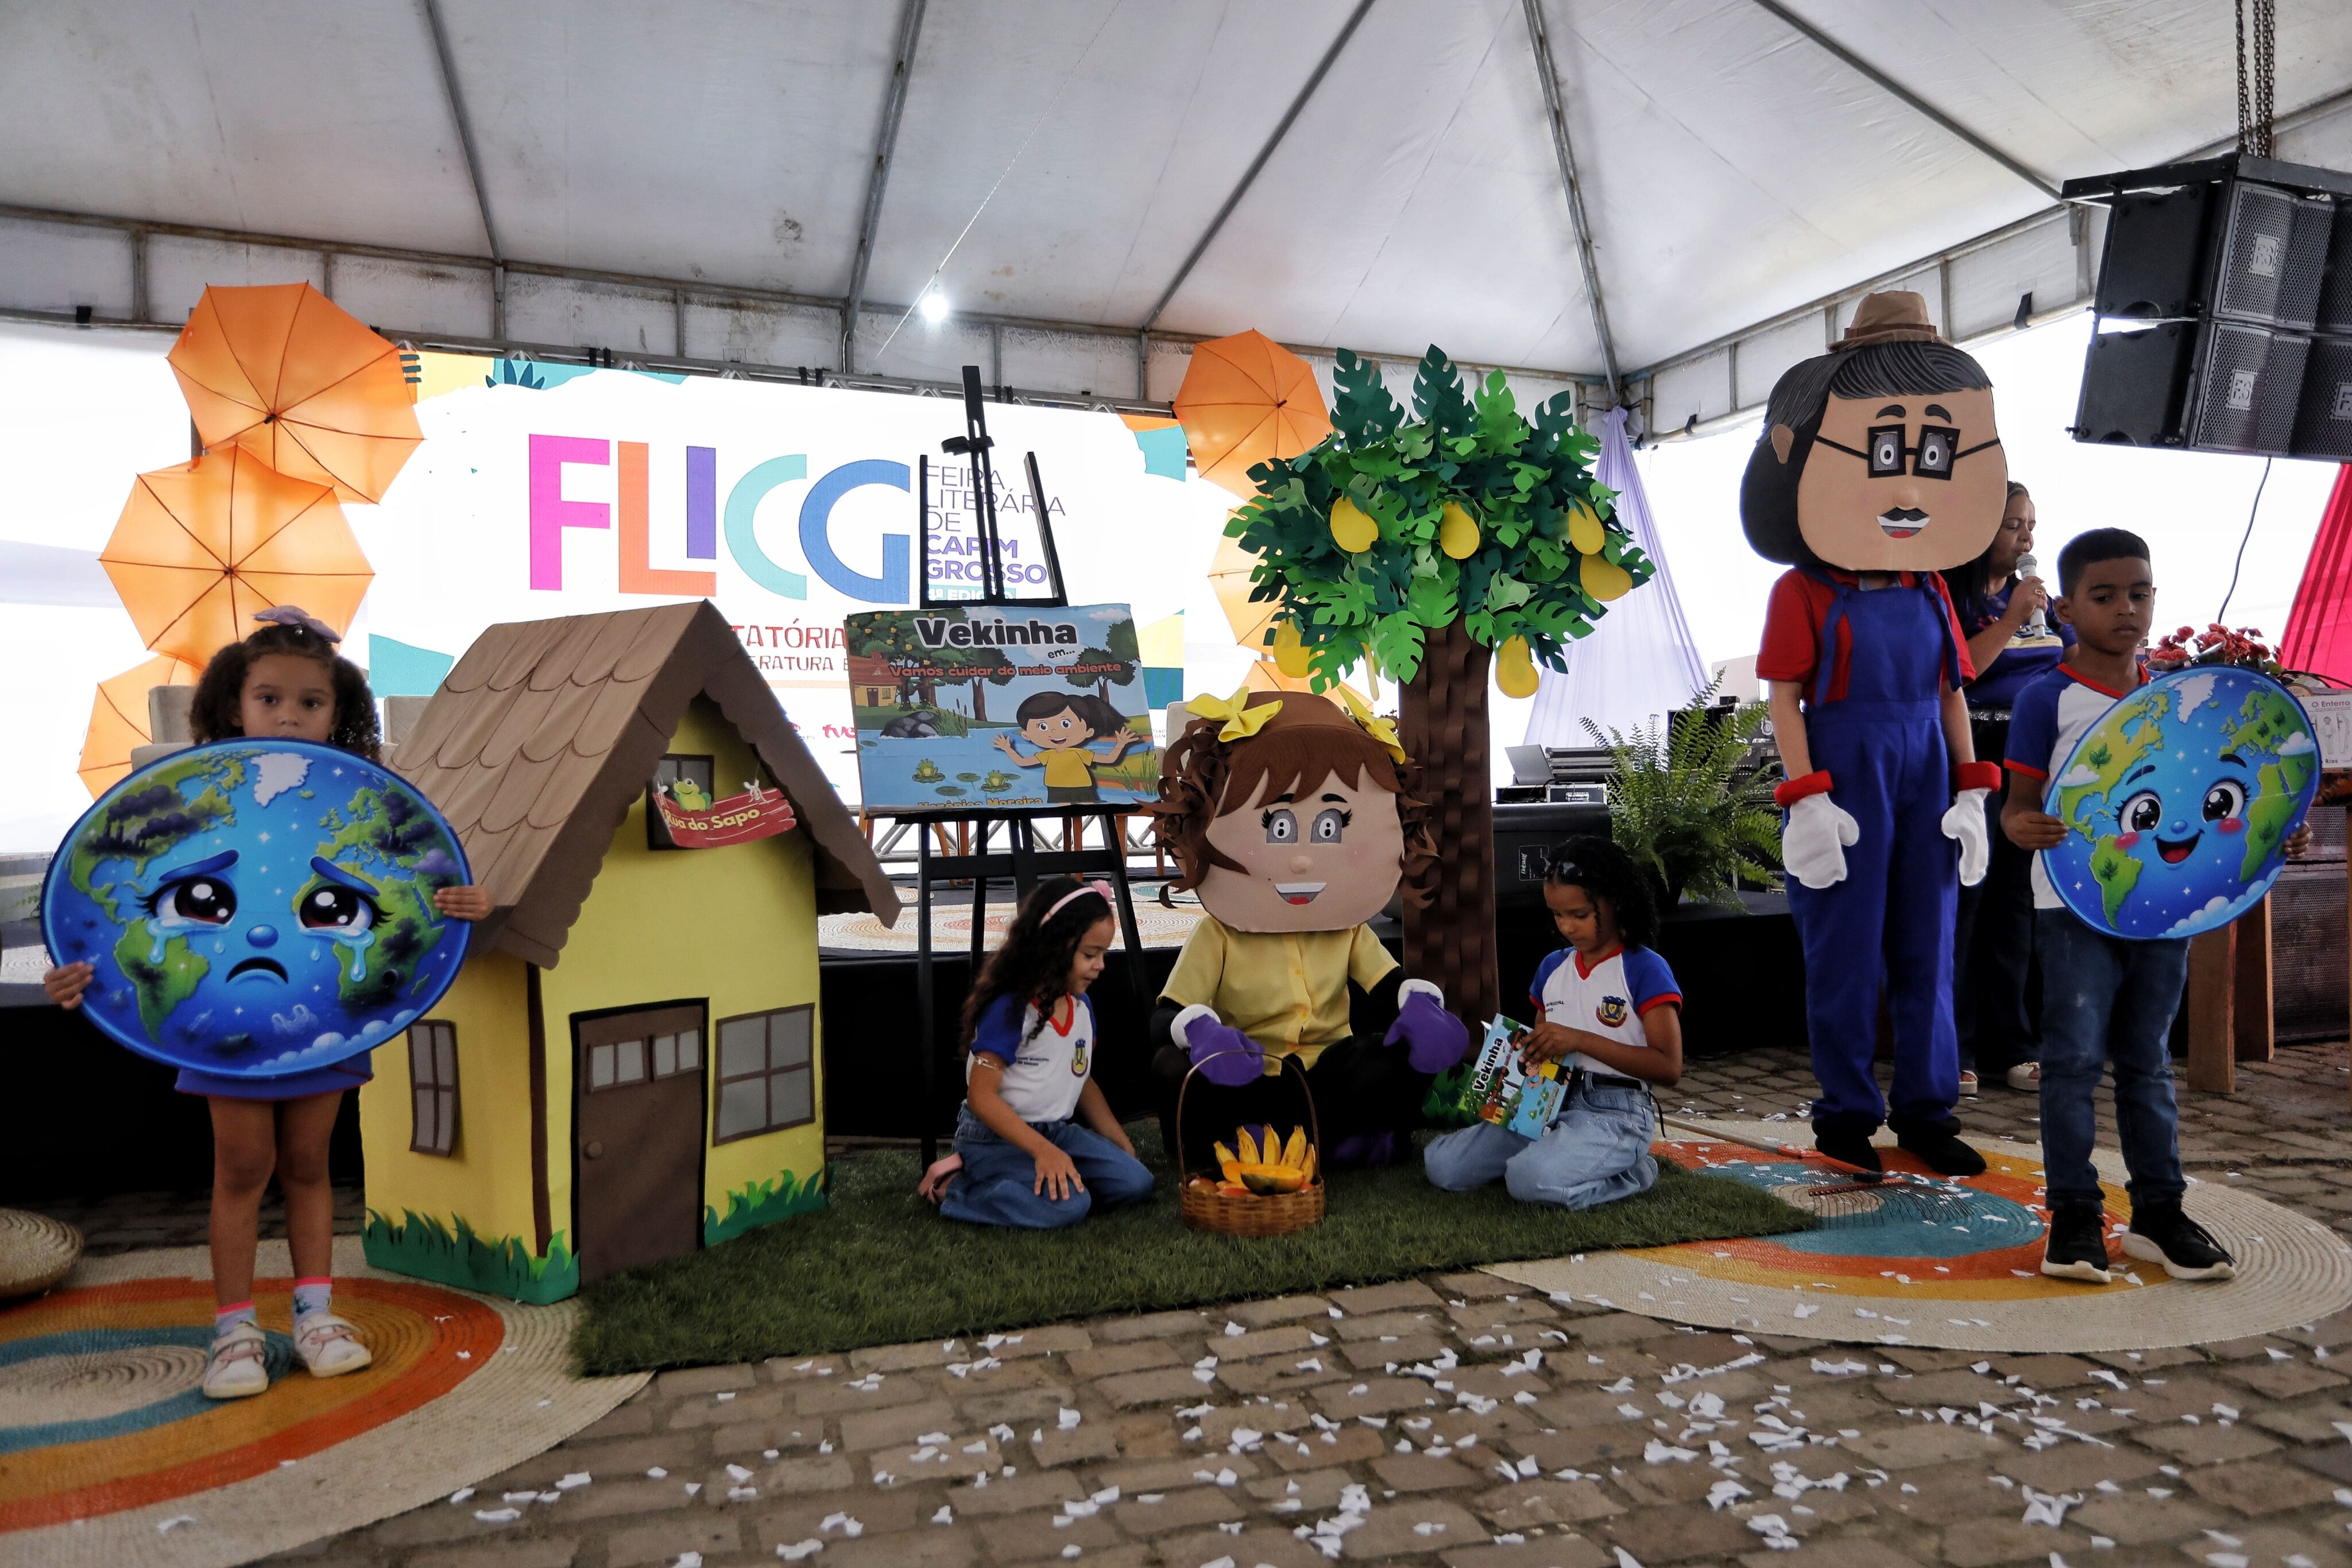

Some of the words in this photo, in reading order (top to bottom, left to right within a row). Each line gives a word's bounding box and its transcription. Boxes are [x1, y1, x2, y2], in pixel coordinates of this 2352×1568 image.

[927, 488, 1066, 516] ITERÁRA
[529, 434, 910, 604] FLICG
[927, 511, 961, 532] DE
[927, 535, 1018, 558] CAPIM
[947, 589, 1013, 601] EDIO
[730, 618, 846, 649] TATÓRIA
[916, 618, 1077, 645] Vekinha
[748, 656, 834, 671] RATURA
[1047, 648, 1076, 659] em...
[888, 665, 944, 677] Vamos
[948, 665, 992, 676] cuidar
[997, 665, 1016, 676] do
[1018, 664, 1052, 676] meio
[1055, 663, 1121, 675] ambiente
[987, 796, 1043, 807] Moreira
[665, 809, 687, 828] Rua
[688, 818, 708, 830] do
[710, 809, 760, 828] Sapo
[1473, 1037, 1503, 1090] Vekinha
